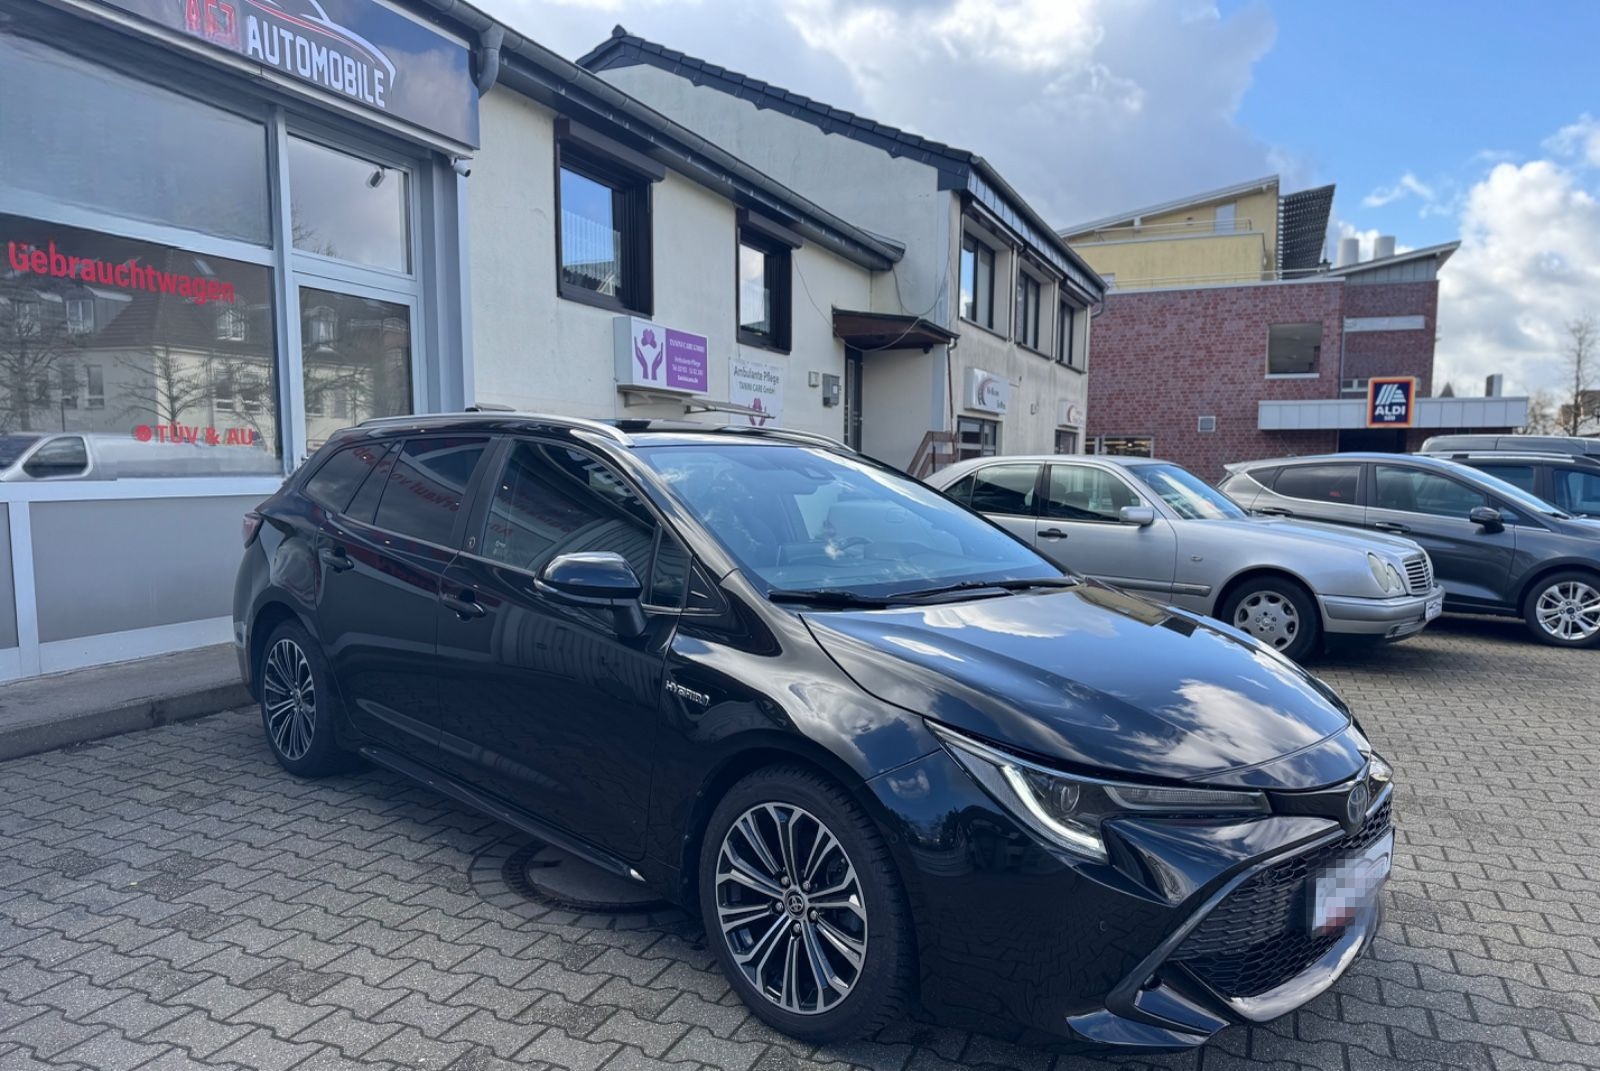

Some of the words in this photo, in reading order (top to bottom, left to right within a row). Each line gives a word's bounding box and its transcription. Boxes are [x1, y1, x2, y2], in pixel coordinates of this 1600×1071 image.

[247, 14, 385, 108] AUTOMOBILE
[8, 240, 235, 305] Gebrauchtwagen
[733, 365, 763, 381] Ambulante
[763, 370, 780, 386] Pflege
[1375, 405, 1406, 415] ALDI
[155, 421, 198, 444] TÜV
[205, 427, 220, 445] &
[227, 428, 253, 445] AU
[665, 679, 710, 706] HYBRID
